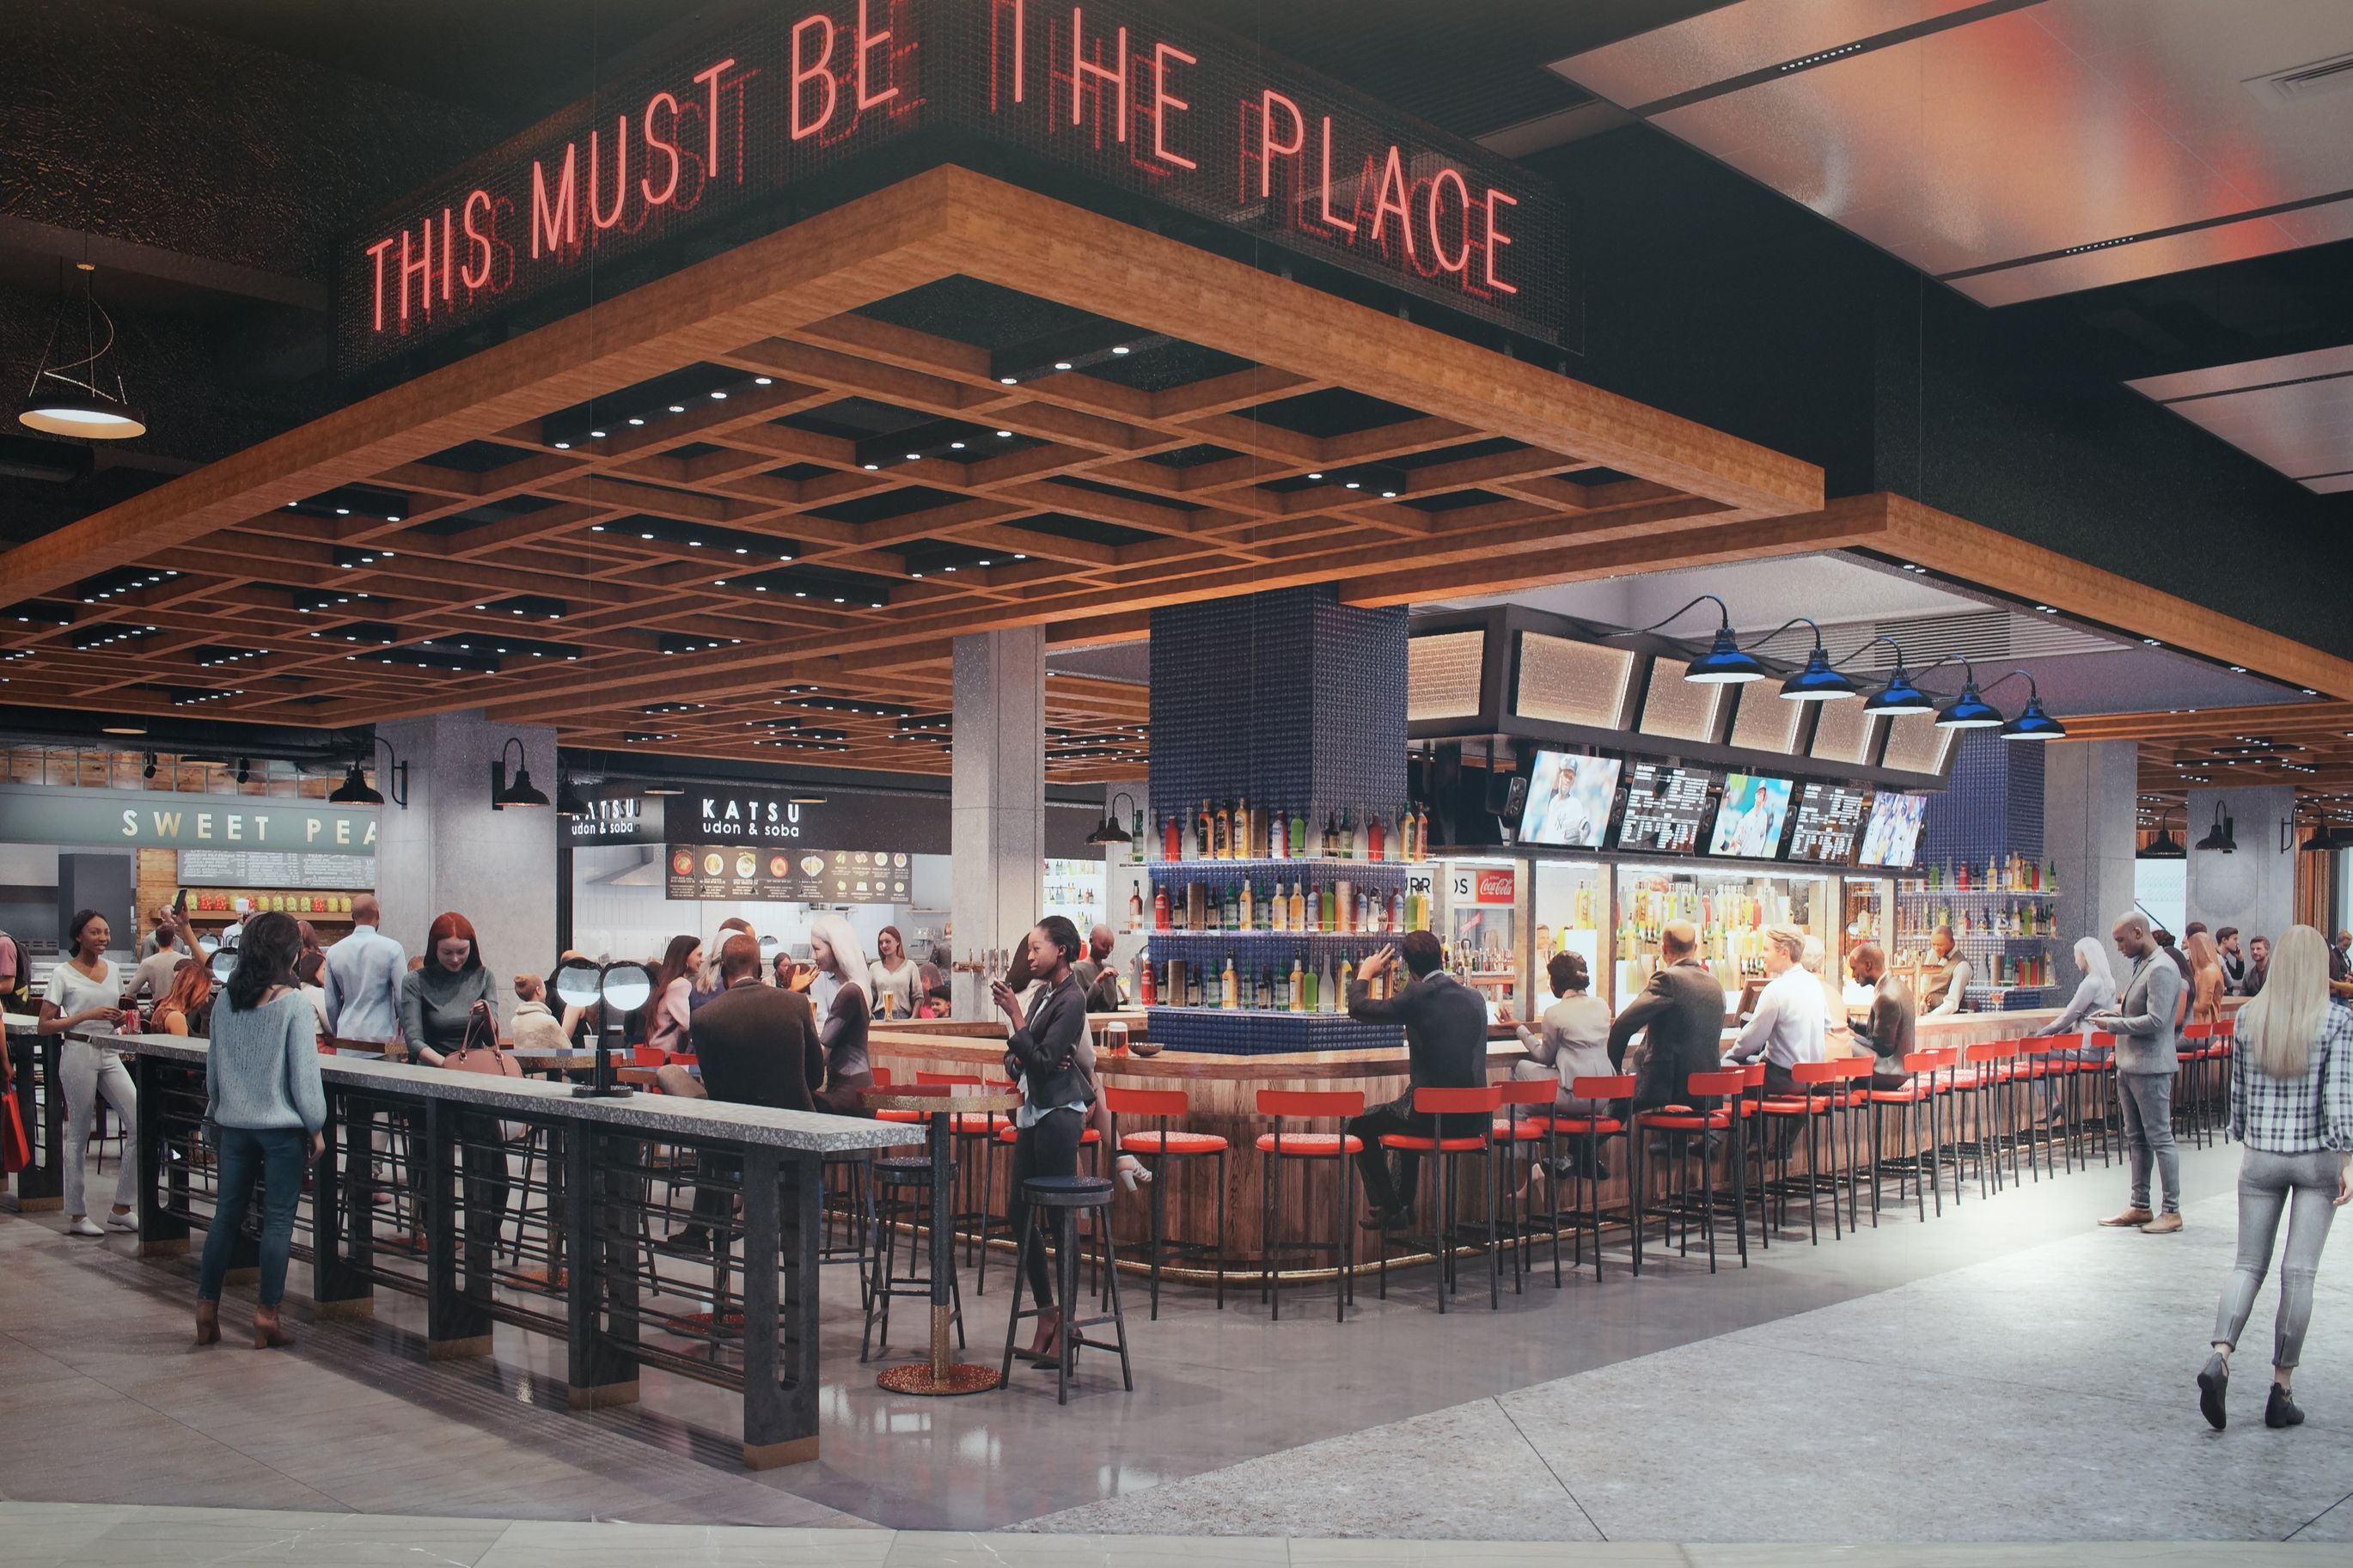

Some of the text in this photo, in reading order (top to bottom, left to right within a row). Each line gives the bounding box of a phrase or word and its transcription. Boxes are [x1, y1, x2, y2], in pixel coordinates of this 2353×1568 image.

[366, 0, 899, 331] THIS MUST BE
[1262, 89, 1518, 294] PLACE
[571, 798, 634, 821] ATSU
[702, 798, 800, 823] KATSU
[121, 809, 269, 841] SWEET
[571, 821, 633, 836] udon & soba
[703, 821, 799, 838] udon & soba
